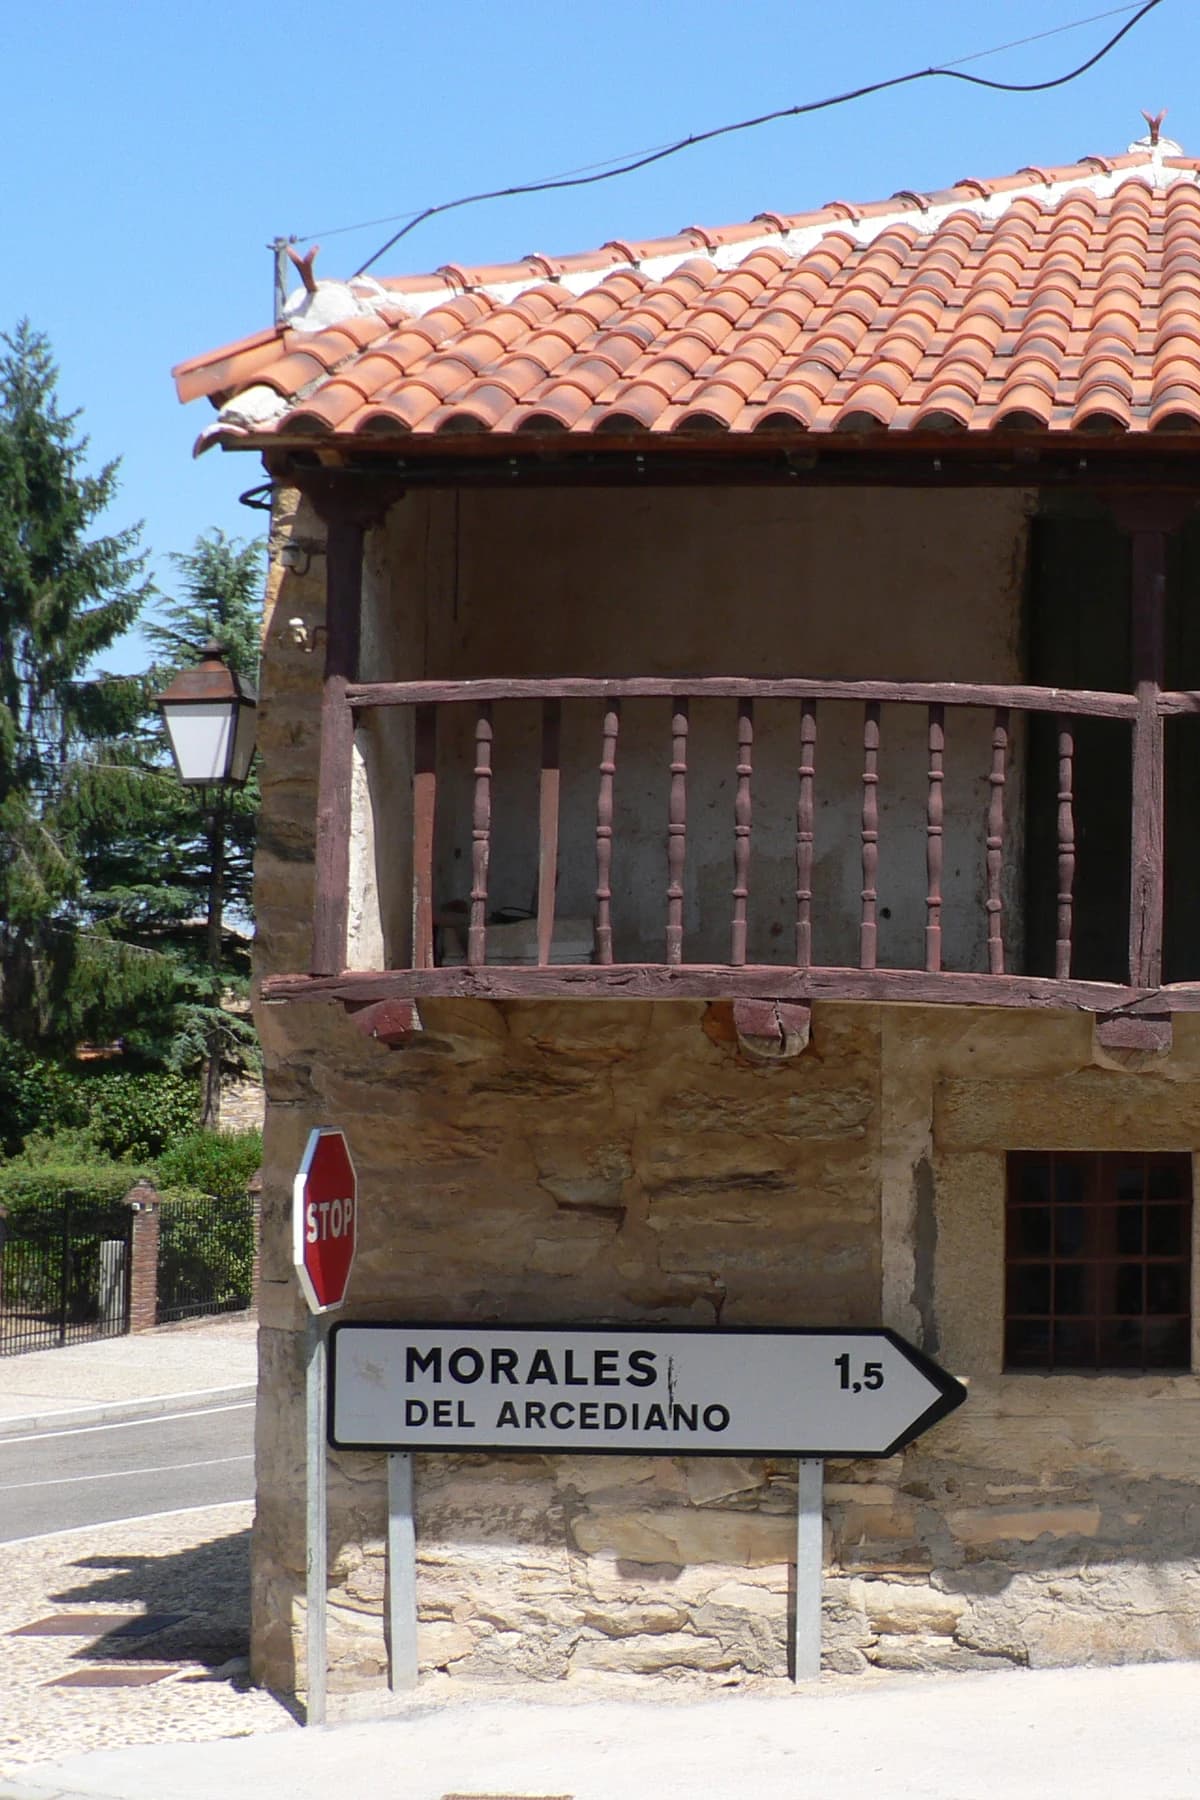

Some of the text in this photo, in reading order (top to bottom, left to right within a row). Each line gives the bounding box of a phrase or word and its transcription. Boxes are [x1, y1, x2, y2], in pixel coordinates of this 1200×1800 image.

[306, 1198, 353, 1243] STOP
[405, 1346, 658, 1387] MORALES
[834, 1353, 884, 1393] 1,5
[405, 1399, 731, 1432] DEL ARCEDIANO
